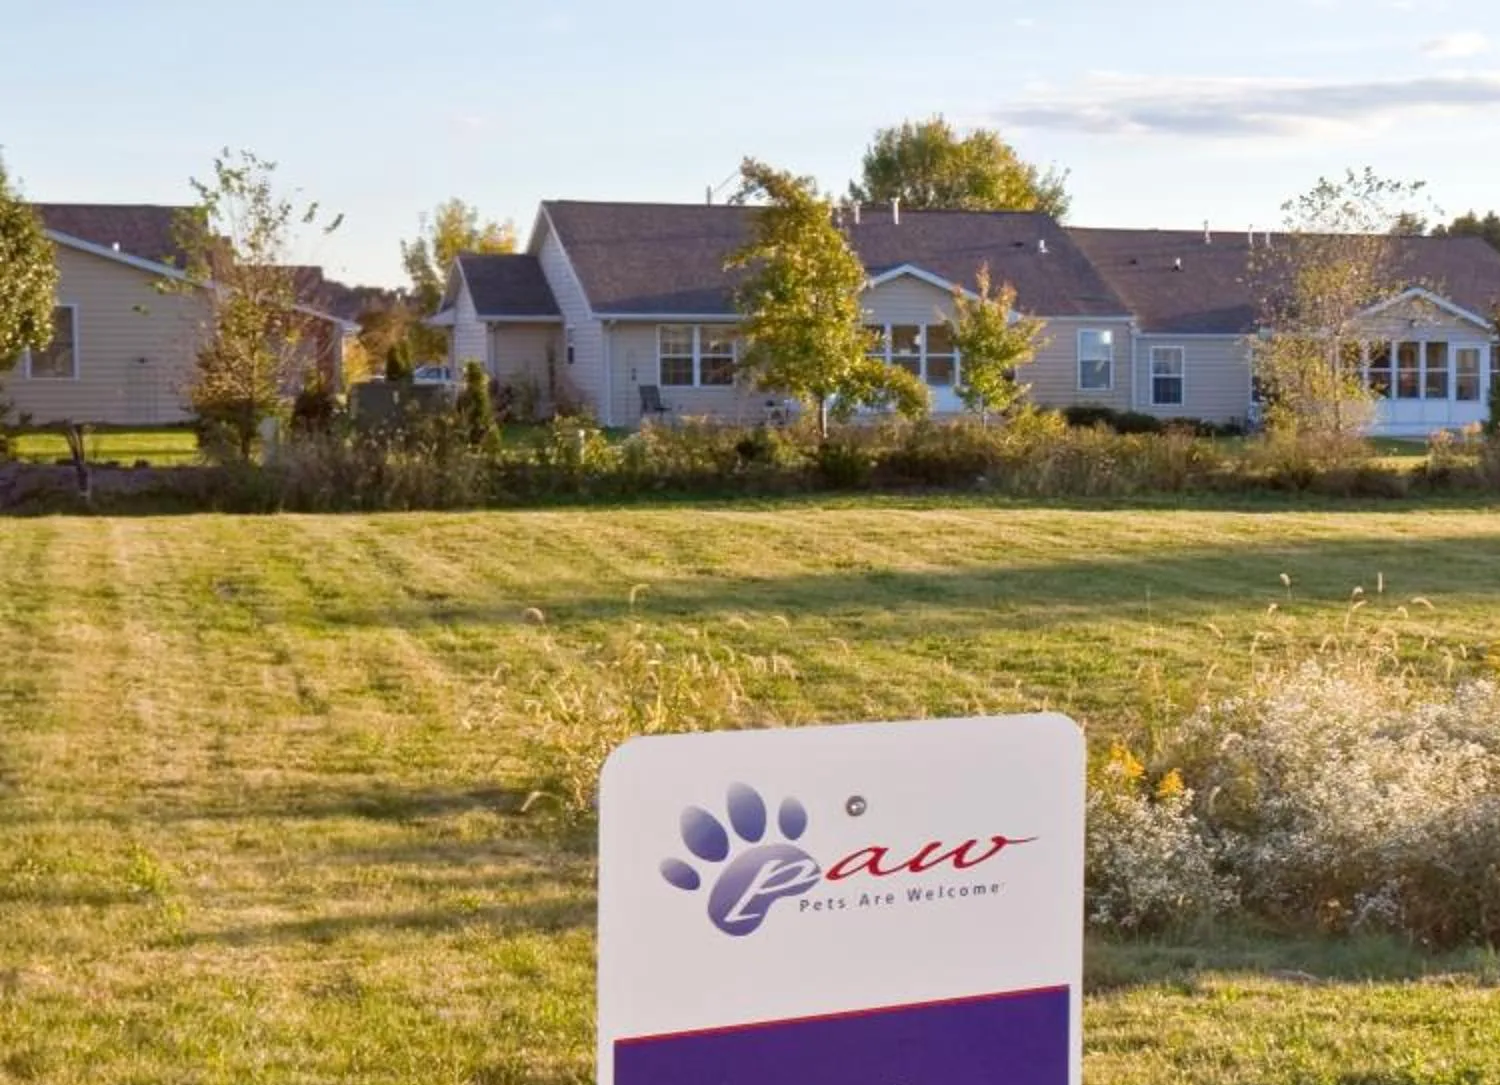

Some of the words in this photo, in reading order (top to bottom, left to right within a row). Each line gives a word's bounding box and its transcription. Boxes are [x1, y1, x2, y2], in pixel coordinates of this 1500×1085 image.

[799, 895, 846, 912] Pets
[859, 889, 895, 907] Are
[907, 881, 1001, 903] Welcome
